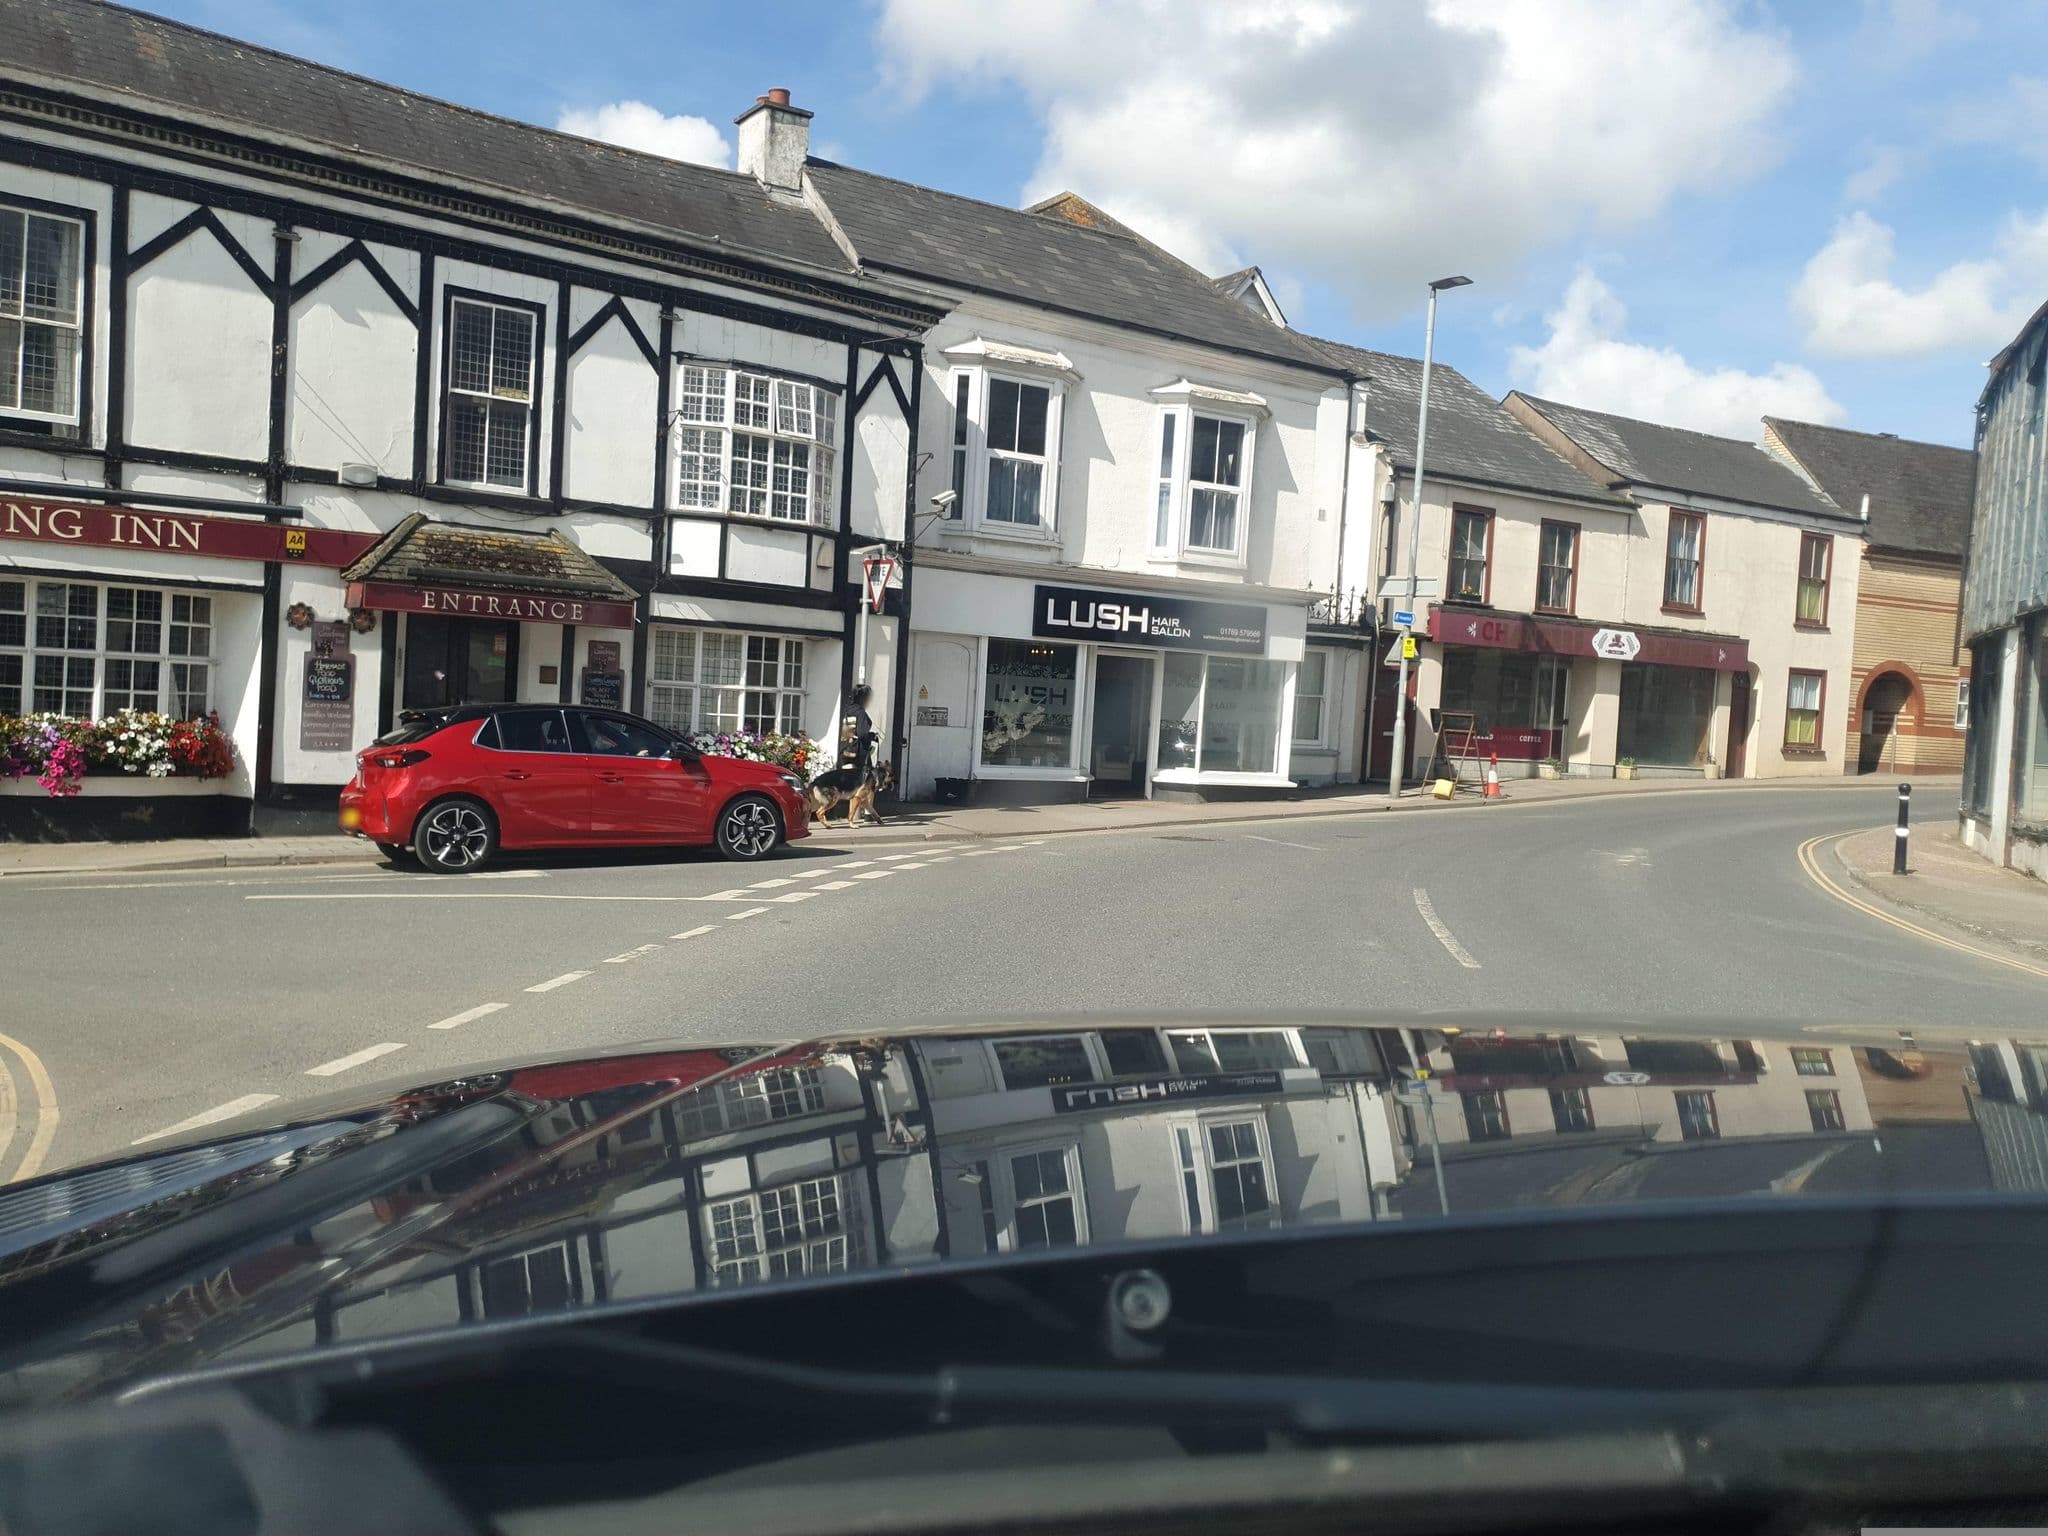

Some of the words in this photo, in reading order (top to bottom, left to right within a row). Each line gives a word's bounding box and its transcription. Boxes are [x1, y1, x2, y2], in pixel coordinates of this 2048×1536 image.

[0, 503, 84, 538] NG
[110, 514, 203, 550] INN
[422, 590, 584, 621] ENTRANCE
[1047, 598, 1149, 634] LUSH
[1151, 616, 1180, 628] HAIR
[1151, 626, 1191, 638] SALON
